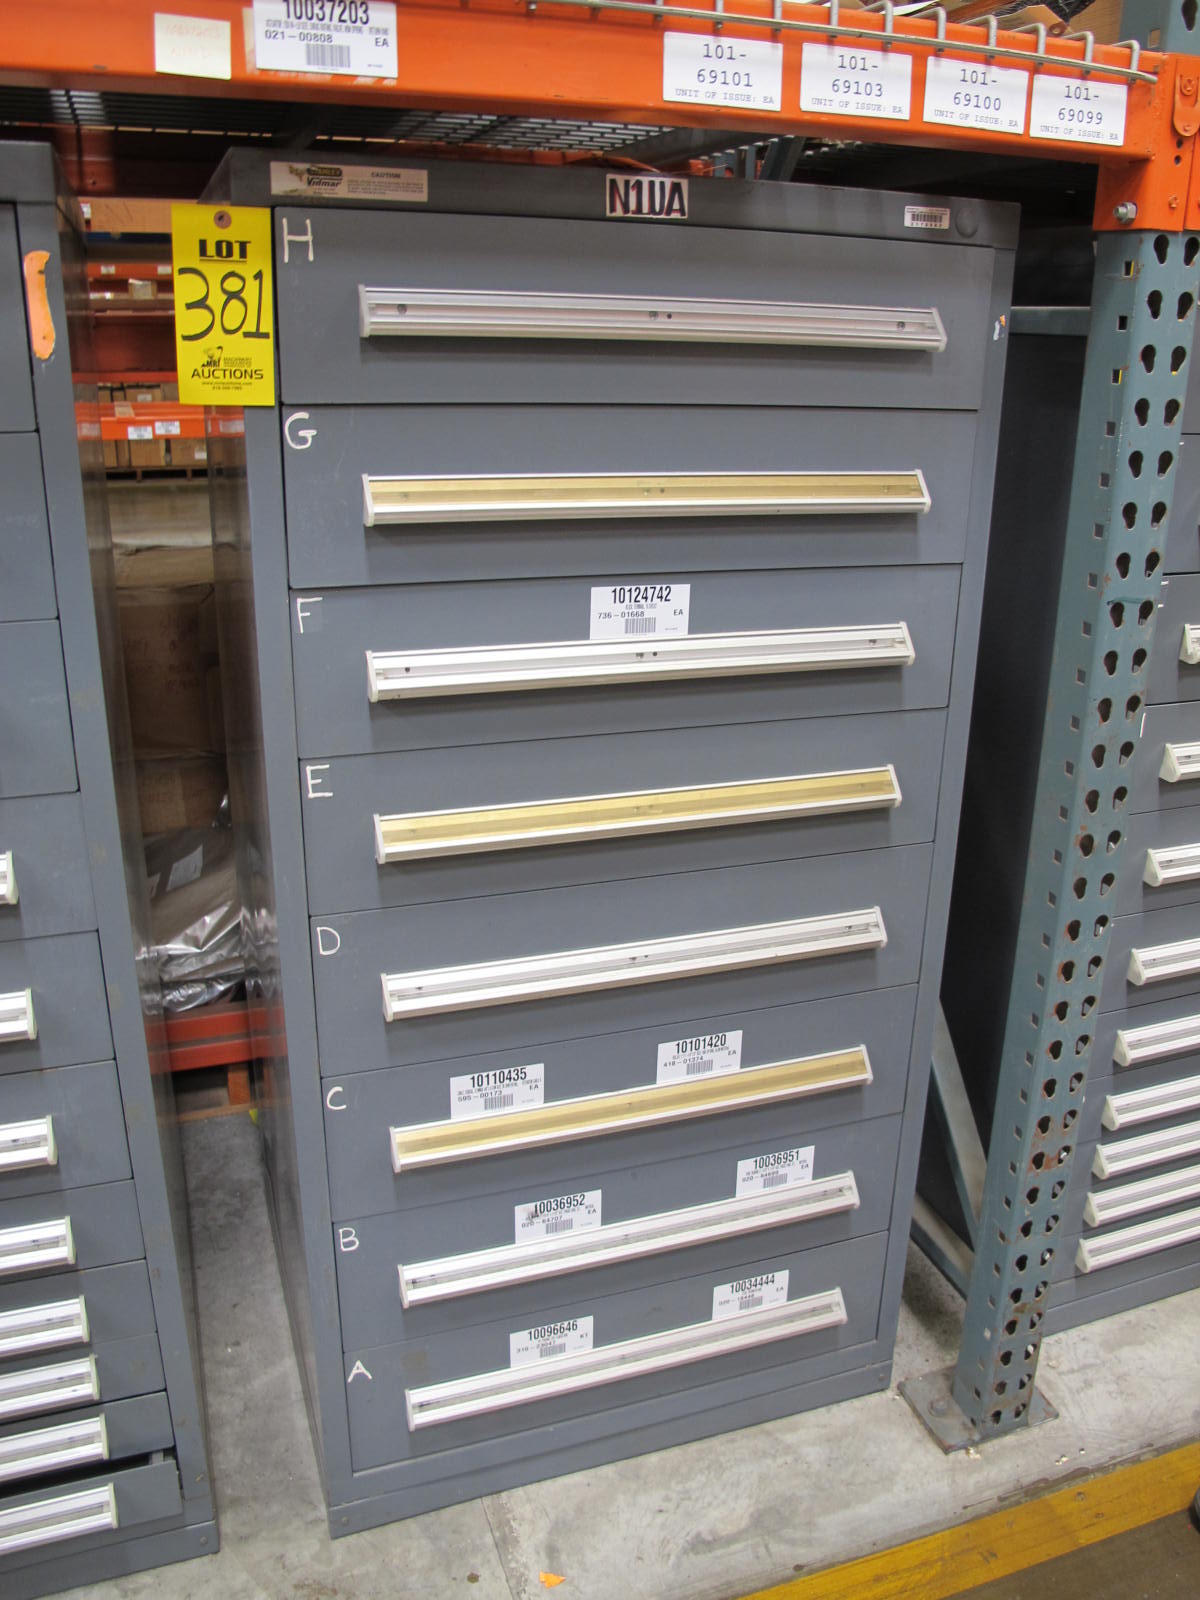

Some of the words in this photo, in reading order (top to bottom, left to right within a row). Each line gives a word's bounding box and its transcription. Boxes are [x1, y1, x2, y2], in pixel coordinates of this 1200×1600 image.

[283, 0, 369, 25] 10037203
[375, 37, 389, 47] EA
[703, 43, 747, 60] 101-
[838, 55, 878, 71] 101-
[697, 68, 753, 87] 69101
[960, 68, 997, 86] 101-
[675, 88, 700, 98] UNIT
[705, 91, 717, 99] OF
[723, 93, 757, 102] ISSUE:
[763, 95, 775, 104] EA
[832, 79, 883, 97] 69103
[1064, 85, 1100, 101] 101-
[811, 97, 833, 107] UNIT
[855, 102, 887, 112] ISSUE:
[892, 105, 903, 114] EA
[953, 92, 1001, 111] 69100
[934, 109, 954, 119] UNIT
[974, 114, 1003, 125] ISSUE:
[1008, 118, 1018, 128] EA
[1058, 107, 1103, 125] 69099
[1040, 125, 1059, 134] UNIT
[1064, 128, 1073, 136] OF
[1078, 129, 1105, 140] ISSUE:
[1110, 133, 1119, 141] EA
[307, 177, 343, 188] Vidmar
[609, 178, 687, 217] N1UA
[198, 239, 252, 260] LOT
[282, 217, 314, 263] H
[177, 266, 270, 341] 381
[191, 368, 264, 380] AUCTIONS
[283, 411, 318, 450] G
[611, 586, 672, 604] 10124742
[296, 596, 323, 634] F
[673, 608, 684, 616] EA
[305, 763, 334, 799] E
[316, 926, 341, 956] D
[676, 1033, 727, 1054] 10101420
[470, 1067, 527, 1088] 10110435
[326, 1085, 347, 1111] C
[753, 1150, 799, 1169] 10036951
[533, 1193, 586, 1215] 10036952
[338, 1227, 360, 1252] B
[730, 1273, 775, 1294] 10034444
[528, 1320, 578, 1341] 10096646
[347, 1359, 373, 1383] A
